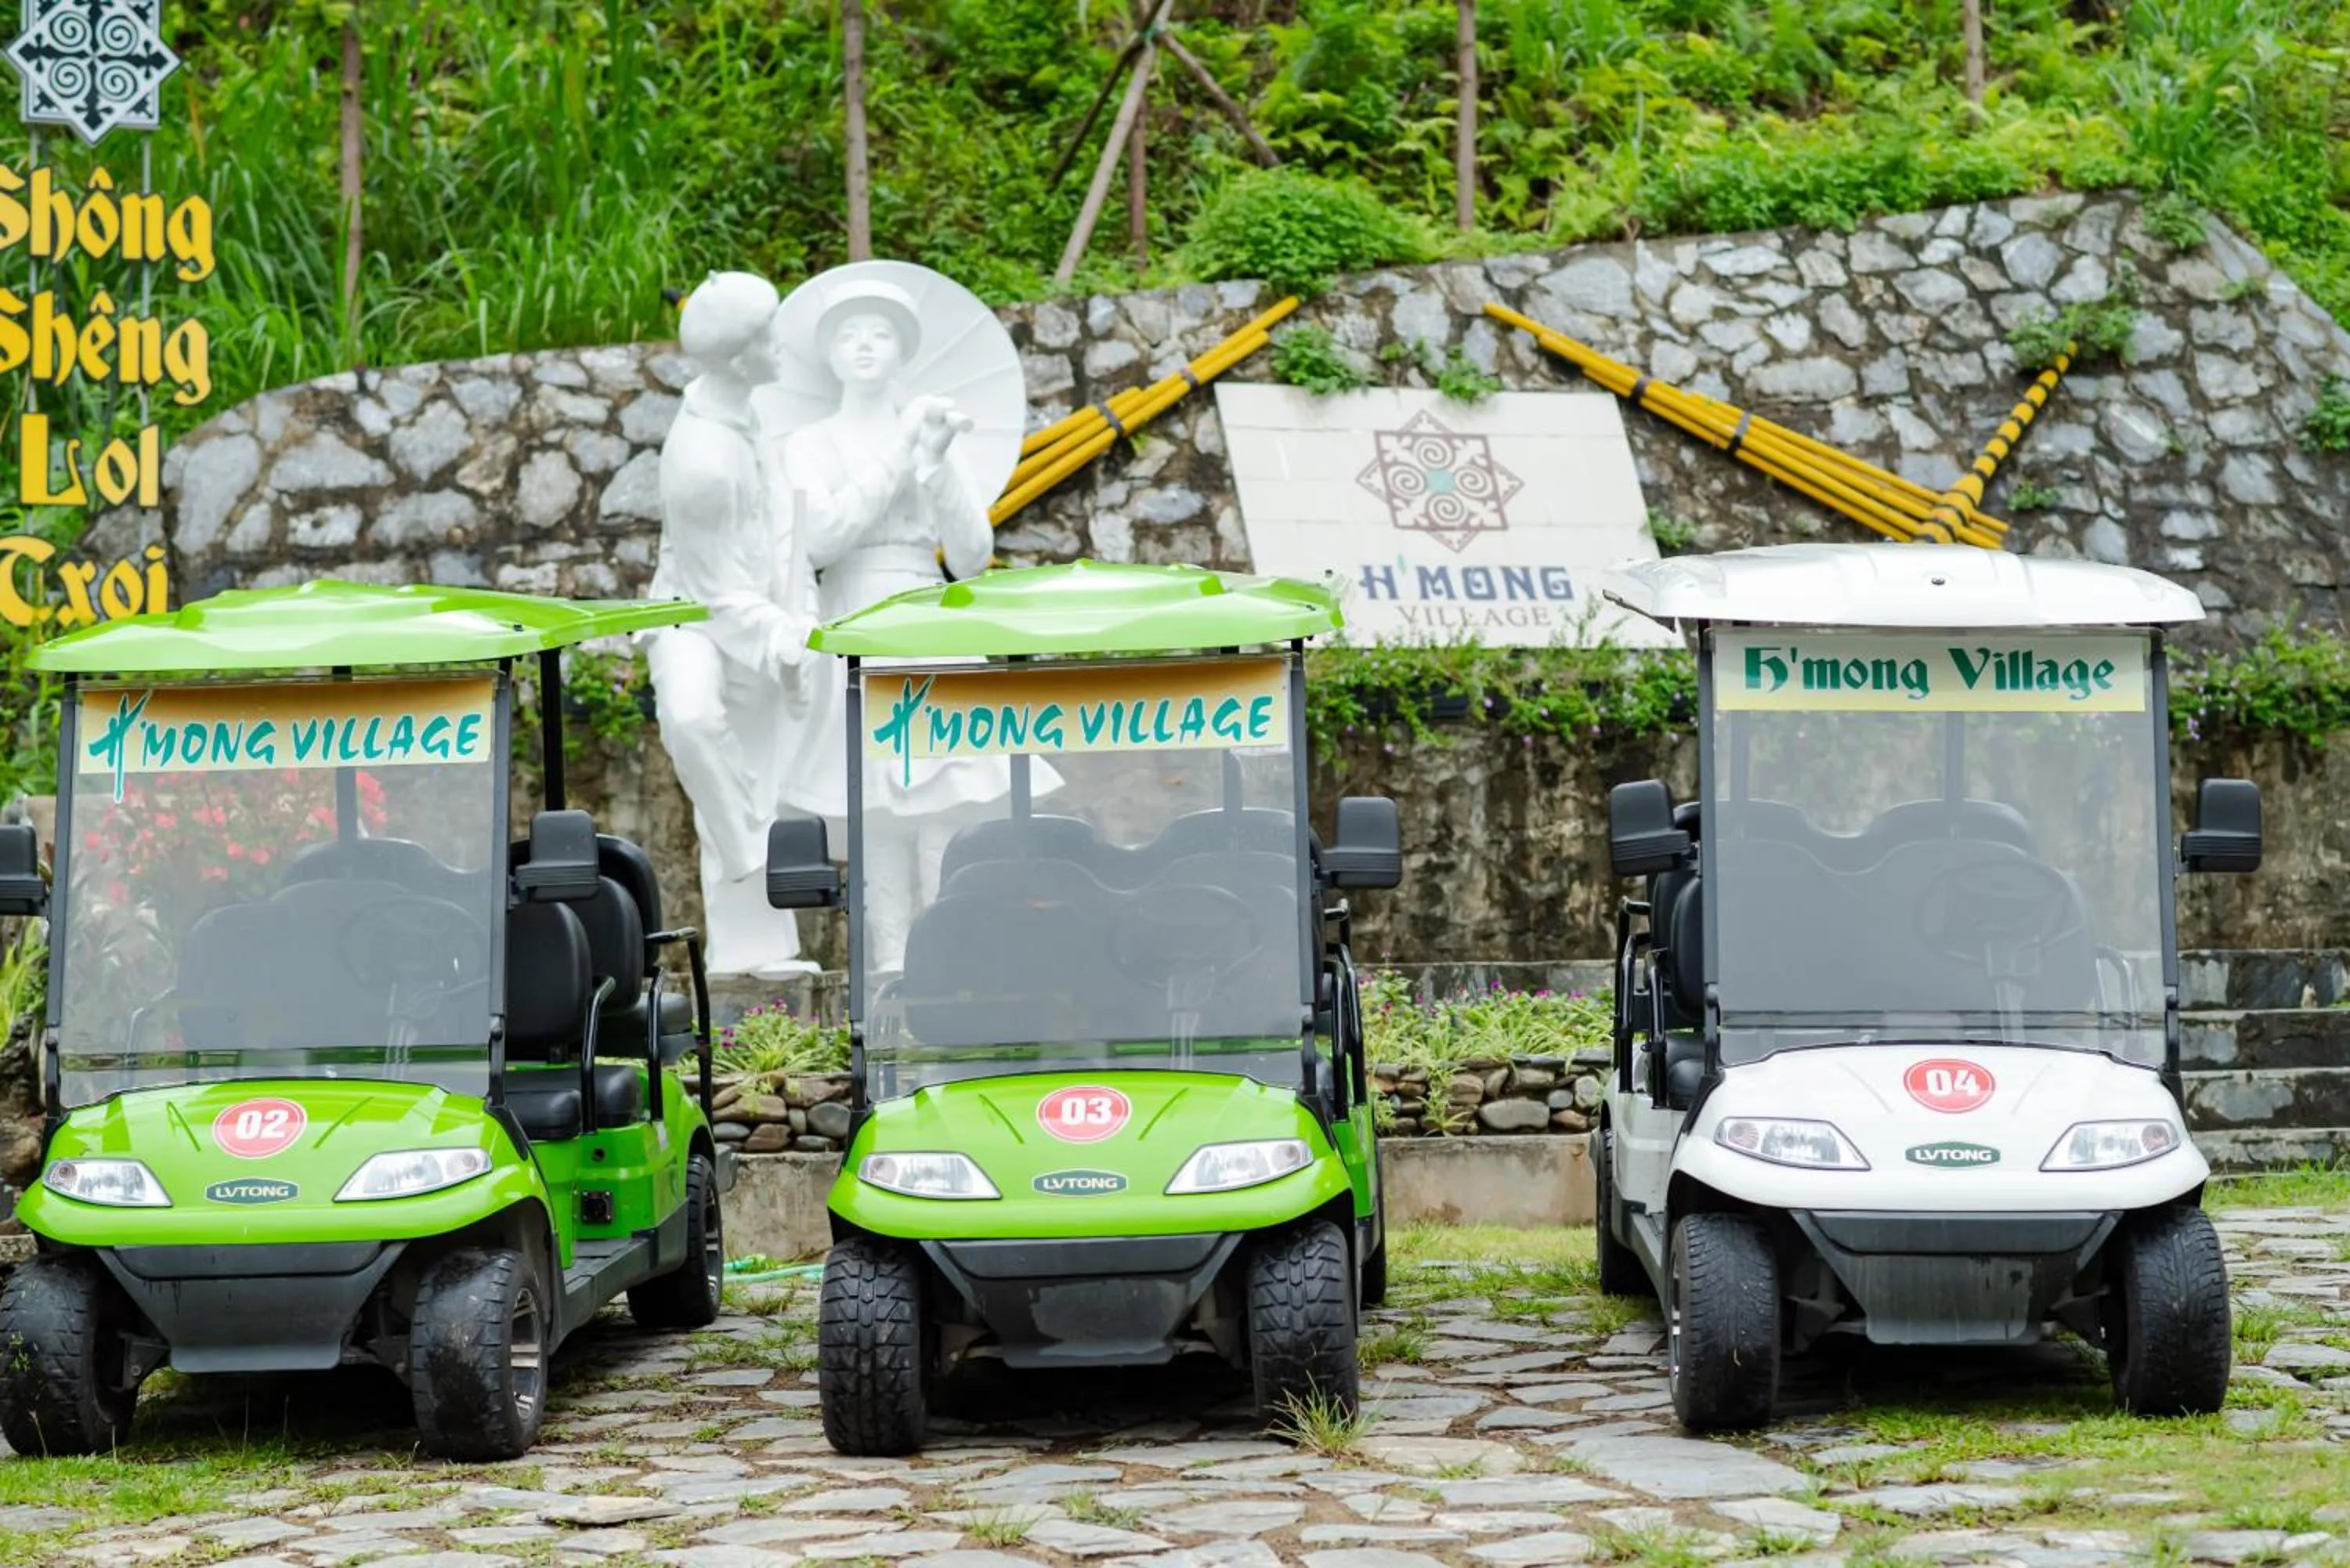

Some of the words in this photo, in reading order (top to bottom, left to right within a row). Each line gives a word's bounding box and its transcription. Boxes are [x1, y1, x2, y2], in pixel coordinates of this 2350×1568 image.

[1358, 553, 1574, 601] H'MONG
[1397, 605, 1553, 628] VILLAGE
[1947, 647, 2116, 701] Village
[873, 674, 1065, 788] H'MONG
[1079, 695, 1274, 746] VILLAGE
[87, 689, 277, 803] H'MONG
[291, 713, 483, 762] VILLAGE
[1925, 1068, 1981, 1097] 04
[234, 1108, 290, 1140] 02
[1061, 1097, 1113, 1125] 03
[1914, 1148, 1992, 1162] LVTONG
[215, 1184, 290, 1198] LVTONG
[1043, 1176, 1119, 1190] LVTONG
